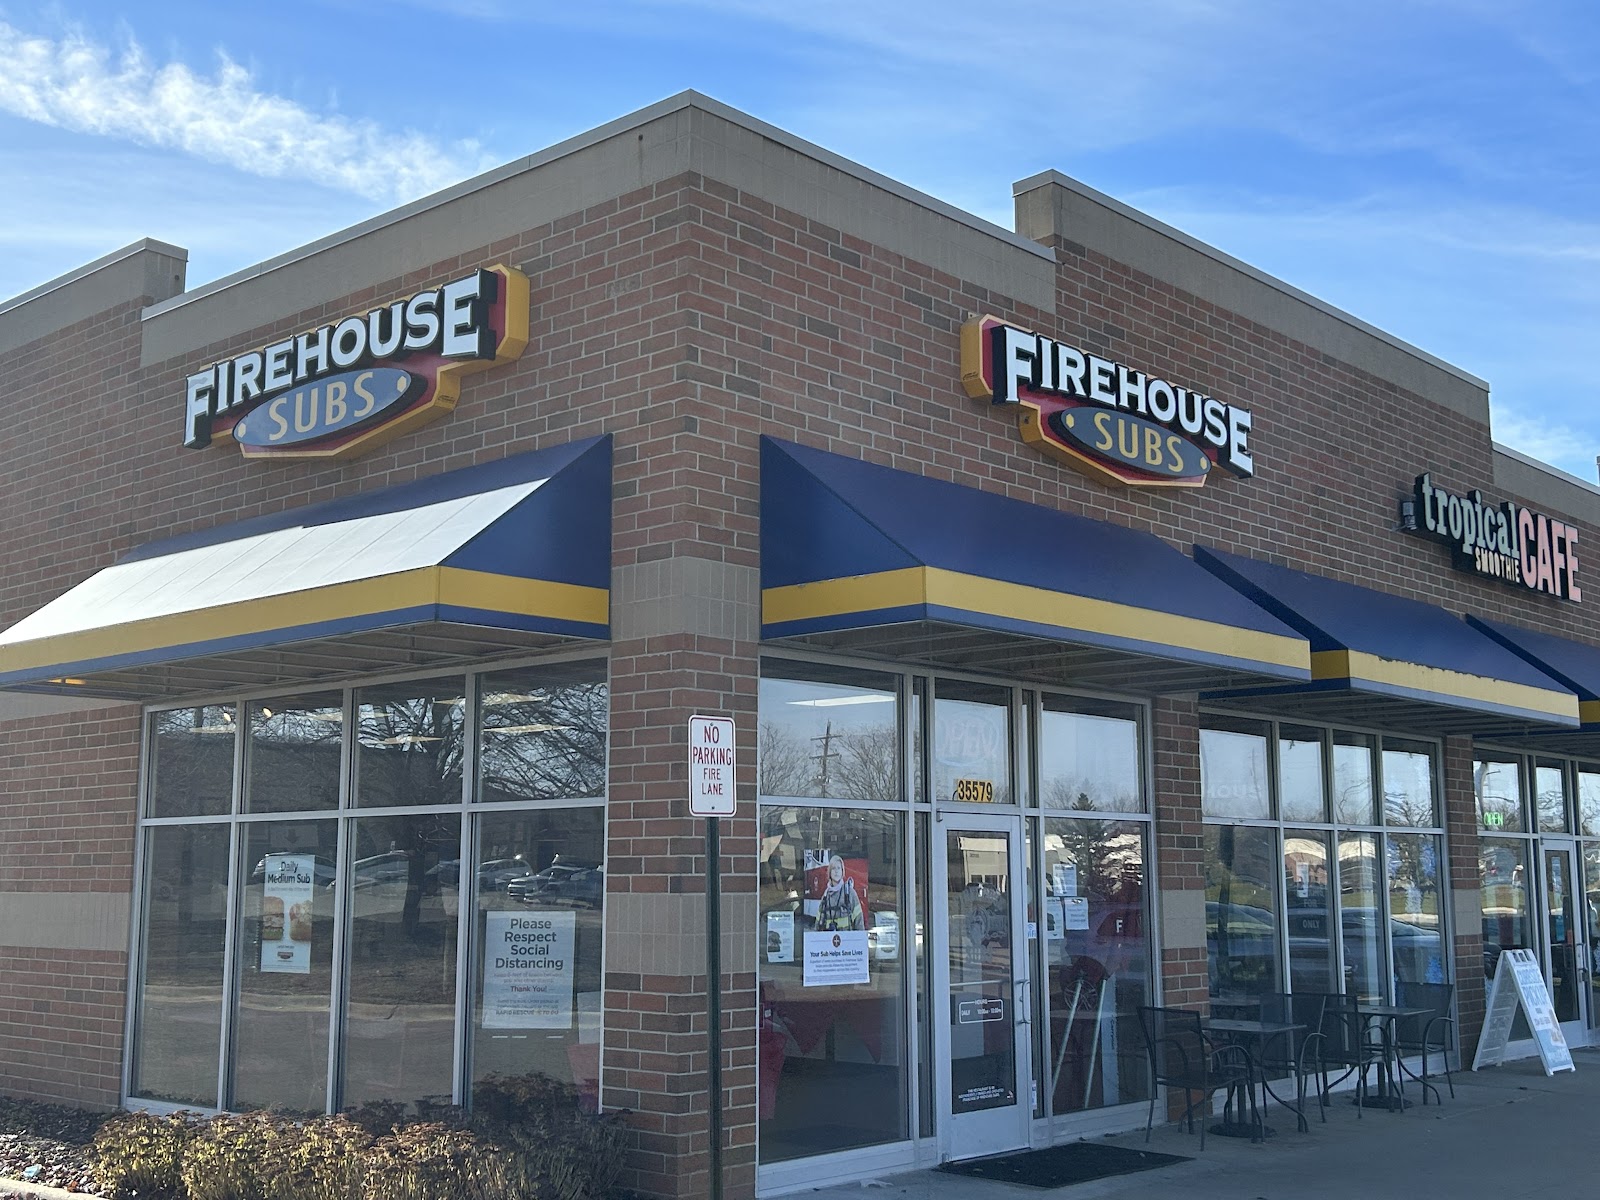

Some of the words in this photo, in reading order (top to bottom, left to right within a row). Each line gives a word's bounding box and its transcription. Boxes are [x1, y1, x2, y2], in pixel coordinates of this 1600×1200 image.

[183, 268, 485, 448] FIREHOUSE
[268, 371, 376, 442] SUBS
[1003, 324, 1254, 479] FIREHOUSE
[1093, 411, 1184, 474] SUBS
[1421, 472, 1520, 560] tropical
[1518, 507, 1582, 603] CAFE
[1474, 546, 1521, 584] SMOOTHIE
[704, 725, 720, 743] NO
[693, 746, 732, 766] PARKING
[703, 767, 721, 780] FIRE
[701, 783, 723, 796] LANE
[958, 780, 993, 802] 35579
[280, 861, 299, 873] Daily
[267, 874, 296, 884] Medium
[296, 873, 311, 884] Sub
[510, 918, 552, 930] Please
[1302, 919, 1320, 929] ONLY
[504, 931, 557, 943] Respect
[510, 944, 549, 956] Social
[841, 949, 851, 957] Save
[495, 957, 564, 971] Distancing
[510, 985, 531, 993] Thank
[532, 985, 548, 993] You!
